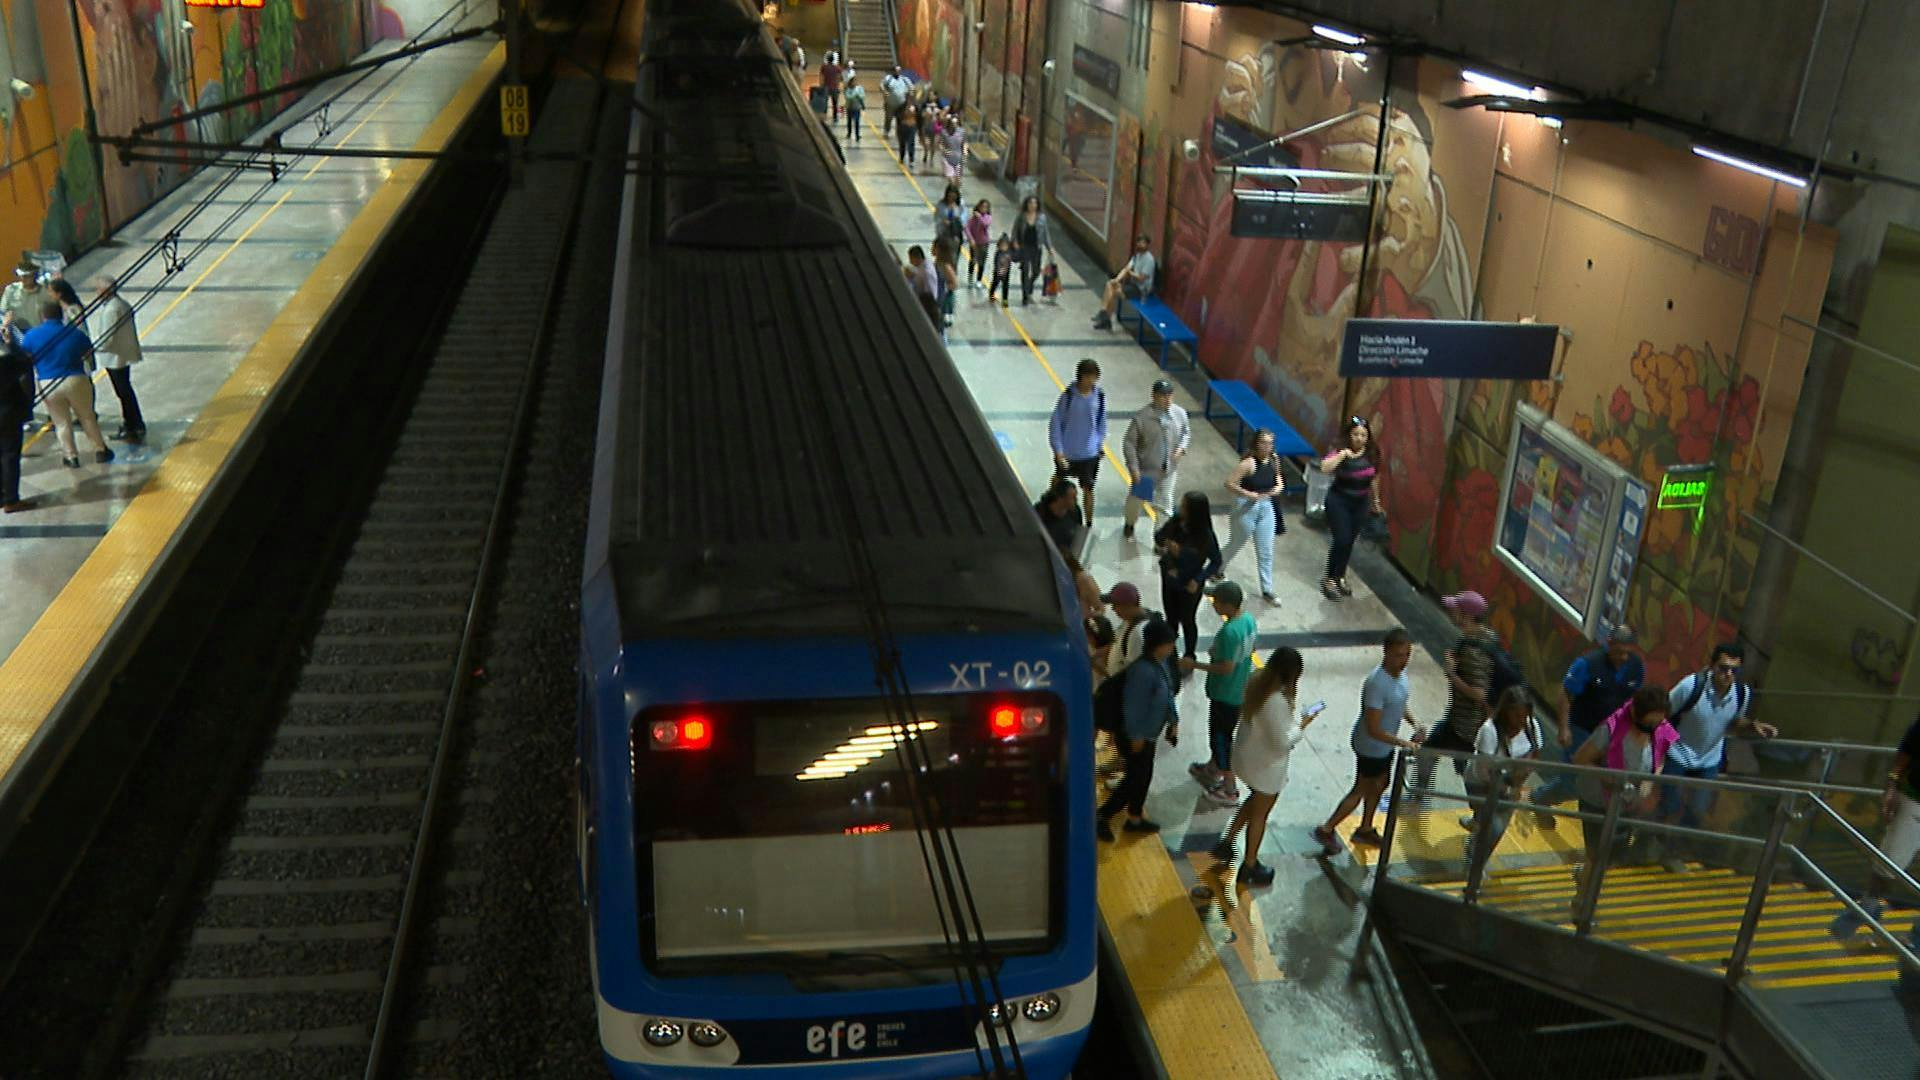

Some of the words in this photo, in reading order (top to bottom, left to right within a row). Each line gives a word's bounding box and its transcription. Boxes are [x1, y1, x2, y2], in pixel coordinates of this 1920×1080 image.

[506, 88, 524, 107] 08
[507, 112, 525, 133] 19
[1359, 345, 1395, 355] Dirección
[1396, 346, 1429, 356] Limache
[949, 660, 1051, 689] XT-02
[806, 1020, 867, 1058] efe
